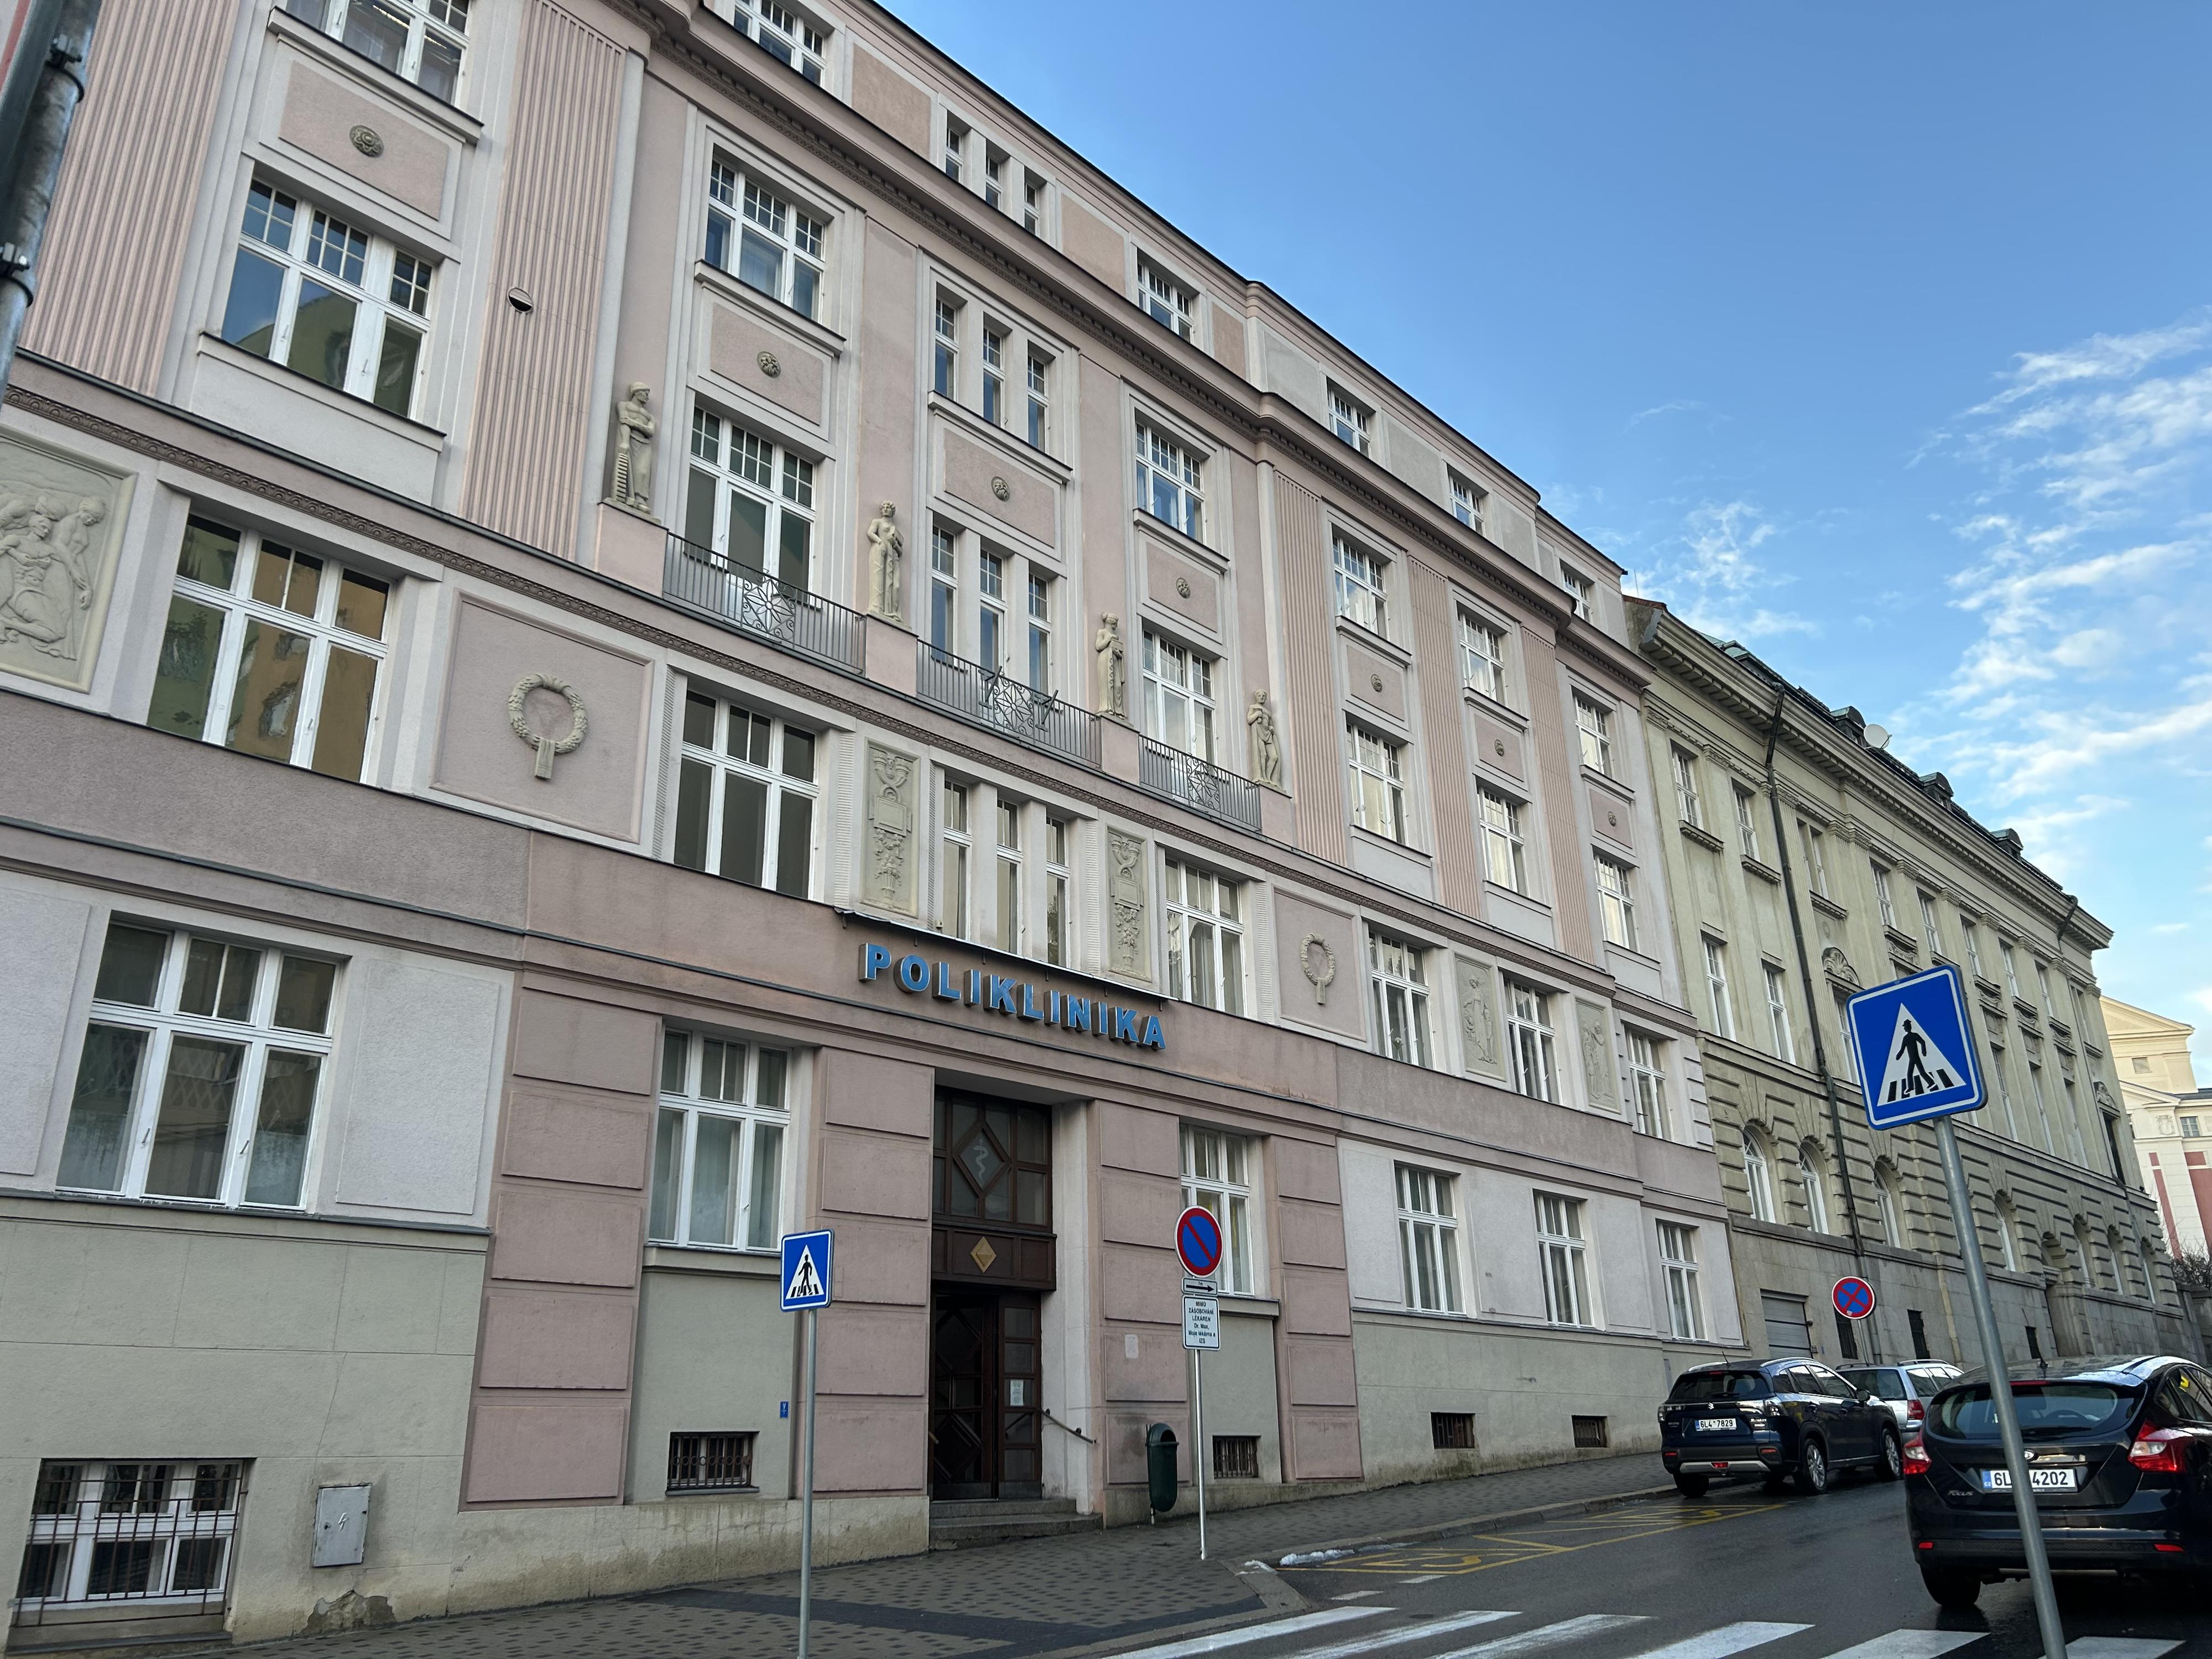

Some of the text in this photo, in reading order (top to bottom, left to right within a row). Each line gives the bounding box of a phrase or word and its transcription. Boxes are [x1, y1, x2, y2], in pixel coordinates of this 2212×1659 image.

[858, 942, 1166, 1050] POLIKLINIKA
[1994, 1471, 2068, 1486] 6L 4202
